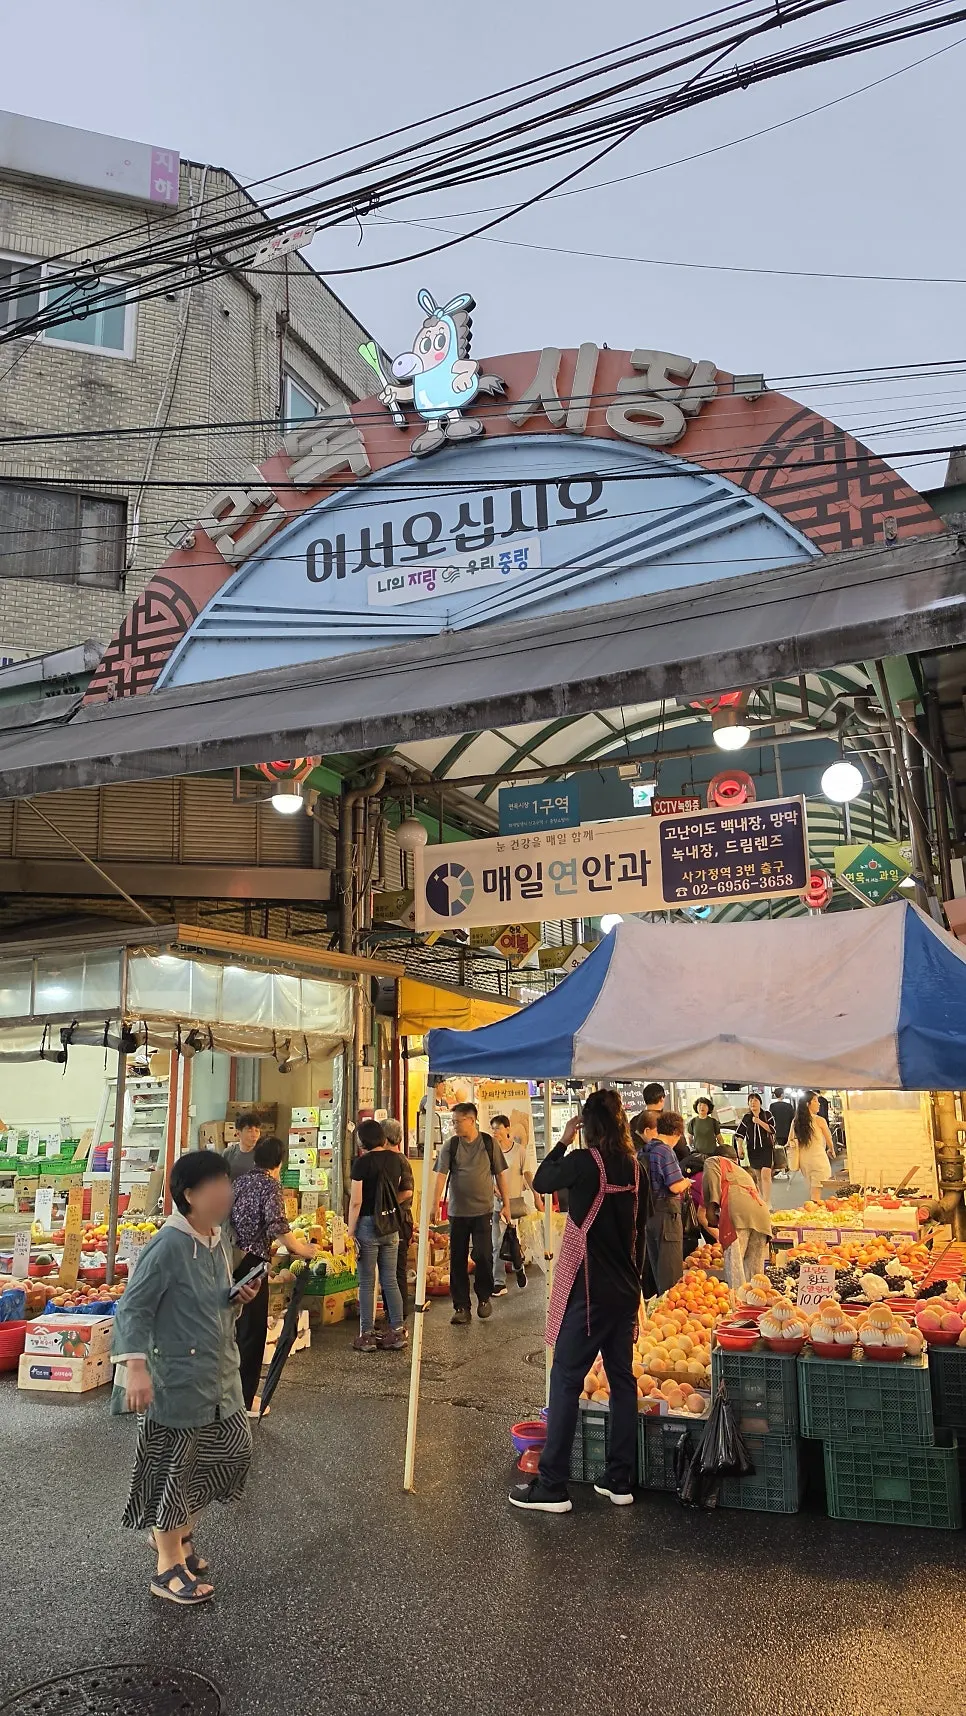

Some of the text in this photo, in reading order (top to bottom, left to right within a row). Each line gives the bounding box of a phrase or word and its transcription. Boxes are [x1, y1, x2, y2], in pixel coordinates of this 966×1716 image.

[154, 151, 174, 200] 지하
[306, 472, 609, 583] 어서오십시오
[377, 547, 530, 593] 나의 자랑 우리 중랑
[532, 795, 569, 815] 1구역
[664, 810, 799, 840] 고난이도 백내장, 망막
[496, 829, 594, 853] 눈 건강을 매일 함께
[671, 834, 784, 862] 녹내장, 드림렌즈
[482, 849, 652, 902] 매일연안과
[681, 860, 785, 883] 사가정역 3번 출구
[692, 873, 794, 896] 02-6956-3658
[879, 869, 899, 882] 과일
[808, 1274, 828, 1286] 황도
